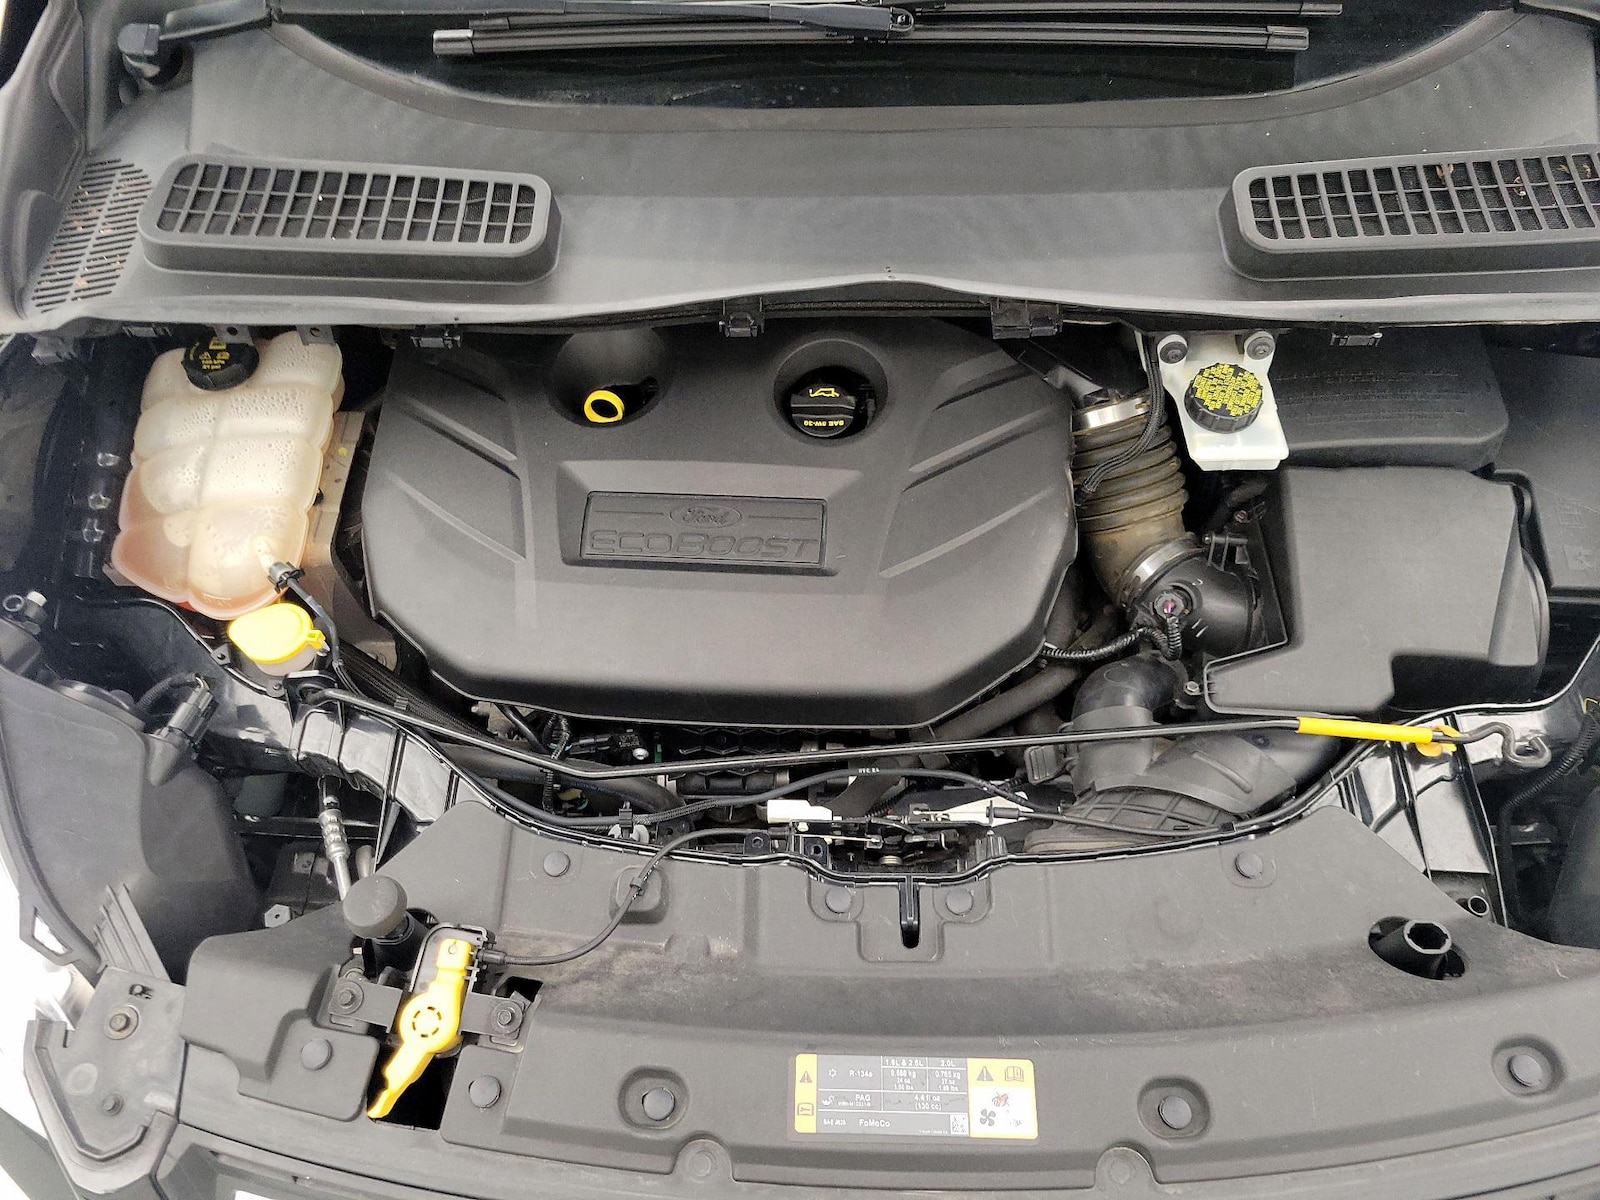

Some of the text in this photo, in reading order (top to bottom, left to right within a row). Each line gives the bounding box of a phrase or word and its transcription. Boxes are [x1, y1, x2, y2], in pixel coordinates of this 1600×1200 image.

[682, 506, 730, 526] Ford
[591, 529, 820, 558] ECOBOOST
[940, 1059, 956, 1067] 2.0L
[849, 1069, 873, 1078] R-134a
[931, 1103, 943, 1111] cc)
[858, 1118, 891, 1128] FoMoCo
